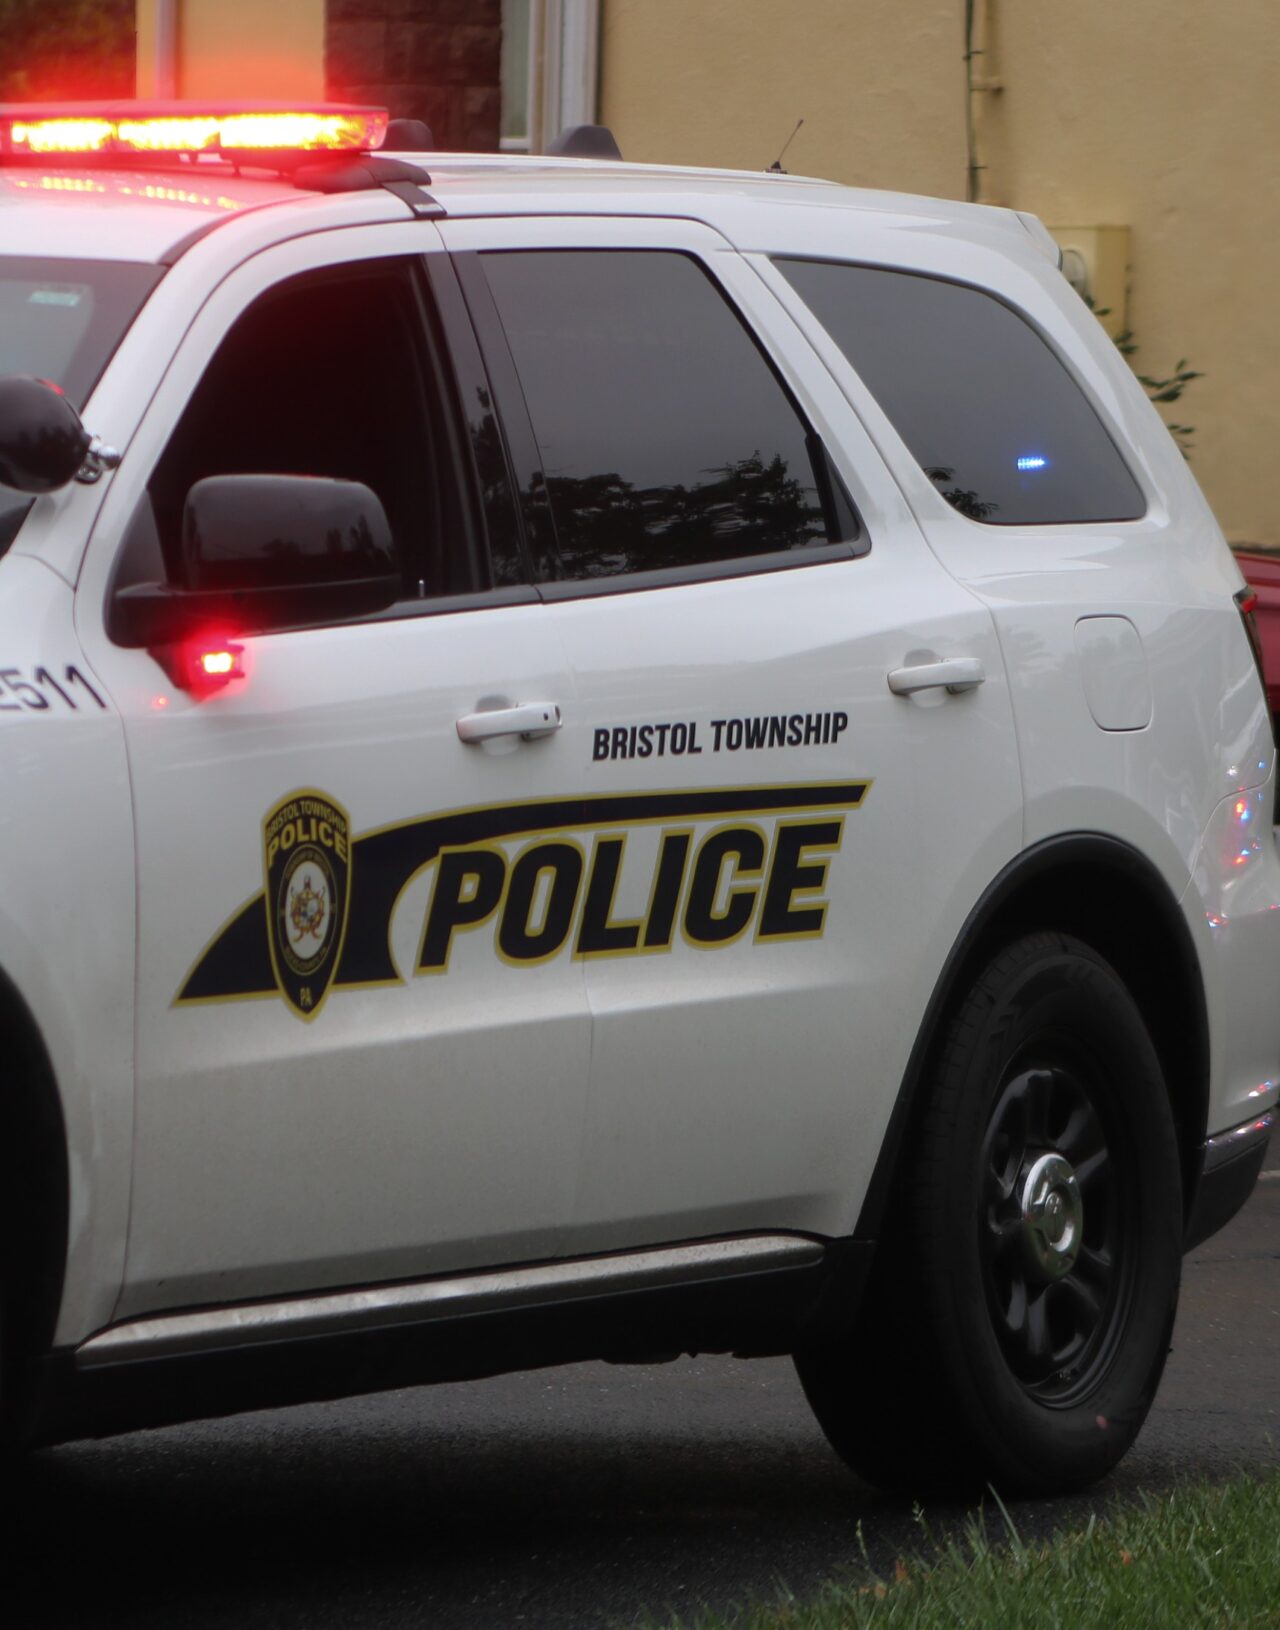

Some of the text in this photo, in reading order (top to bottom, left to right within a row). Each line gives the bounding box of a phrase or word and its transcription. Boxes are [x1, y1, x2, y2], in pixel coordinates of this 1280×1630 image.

[593, 711, 848, 761] BRISTOL TOWNSHIP
[267, 817, 348, 868] POLICE
[414, 815, 847, 977] POLICE
[300, 986, 313, 1007] PA
